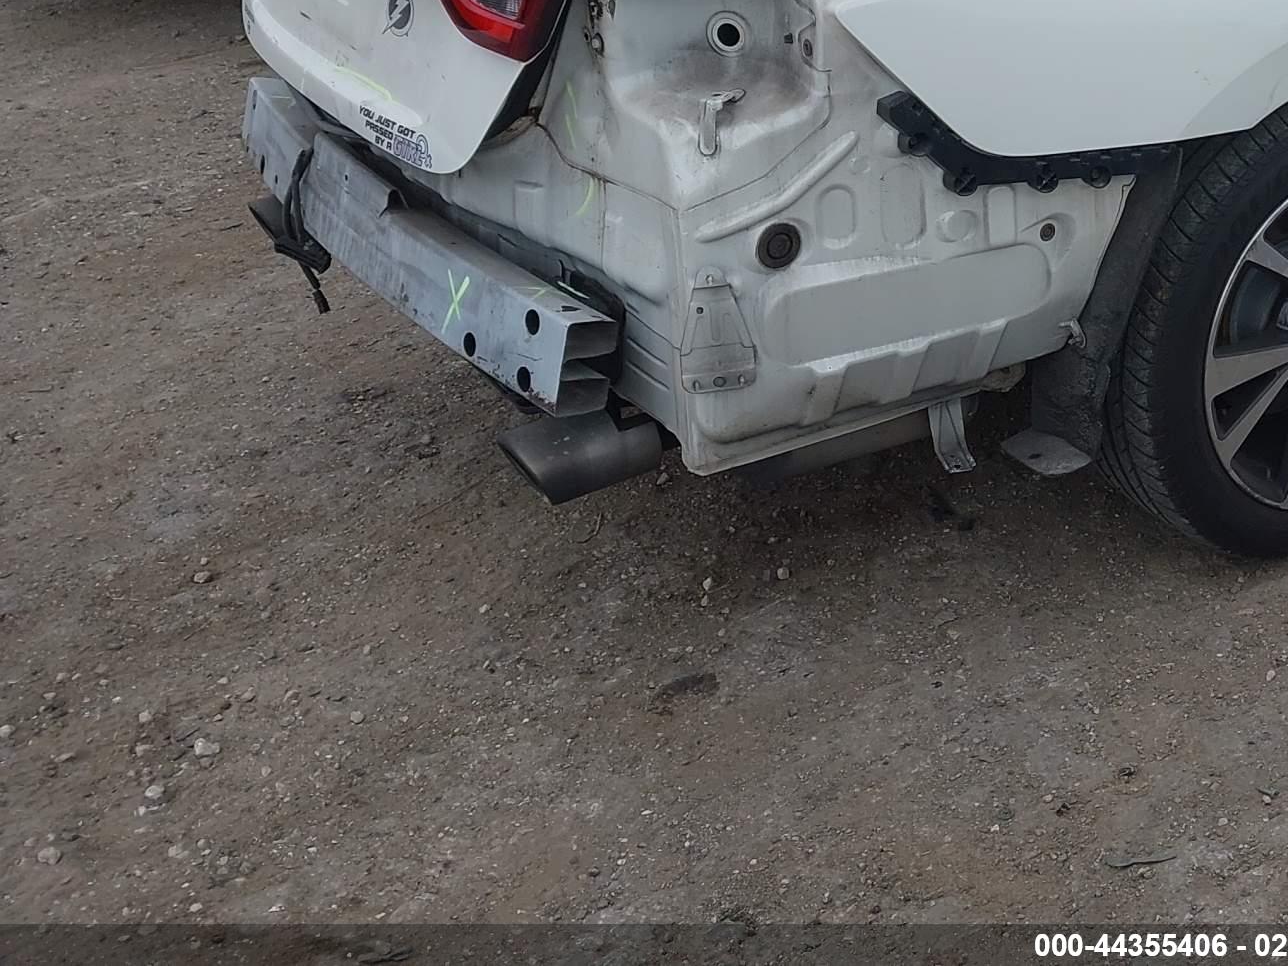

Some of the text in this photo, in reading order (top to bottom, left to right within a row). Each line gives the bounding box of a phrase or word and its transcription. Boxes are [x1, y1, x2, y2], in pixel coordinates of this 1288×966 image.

[359, 105, 417, 139] YOU JUST GOT
[365, 120, 394, 141] PASSED
[375, 135, 386, 147] BY
